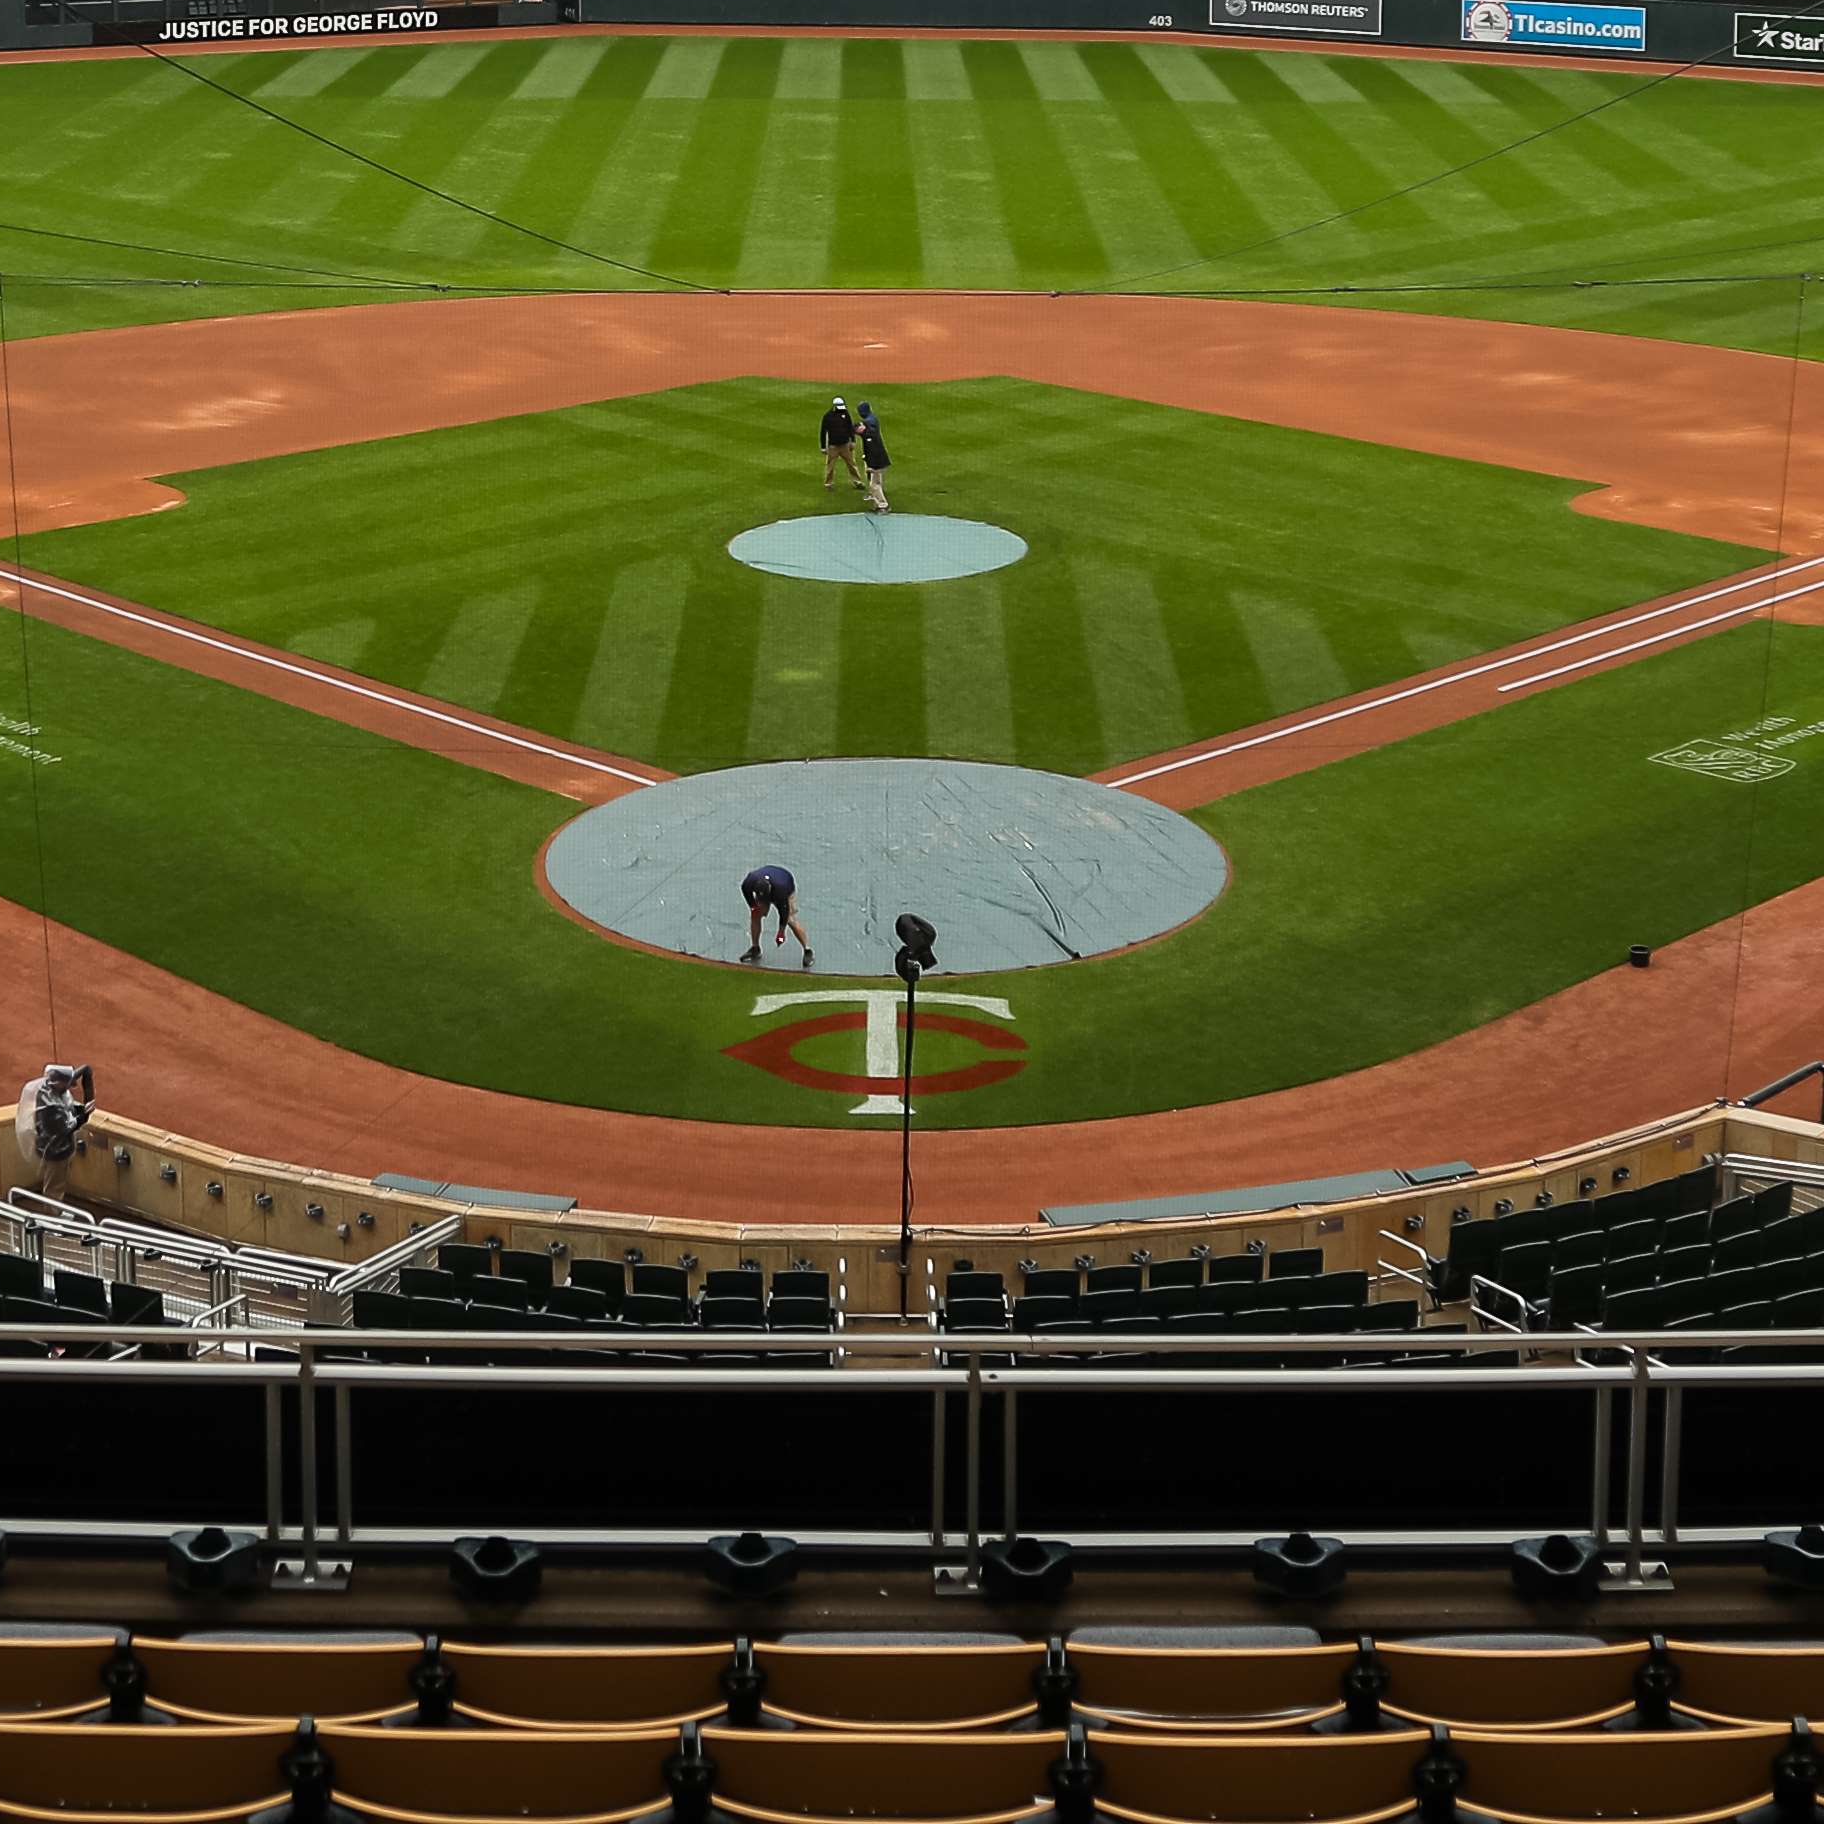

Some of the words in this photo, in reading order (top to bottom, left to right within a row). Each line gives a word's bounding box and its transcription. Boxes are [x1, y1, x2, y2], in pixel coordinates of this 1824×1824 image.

[1251, 0, 1309, 15] THOMSON
[1311, 4, 1369, 18] REUTERS
[159, 19, 244, 41] JUSTICE
[248, 17, 289, 36] FOR
[293, 13, 373, 34] GEORGE
[377, 10, 439, 31] FLOYD
[1149, 14, 1172, 27] 403
[1514, 13, 1642, 39] TIcasino.com
